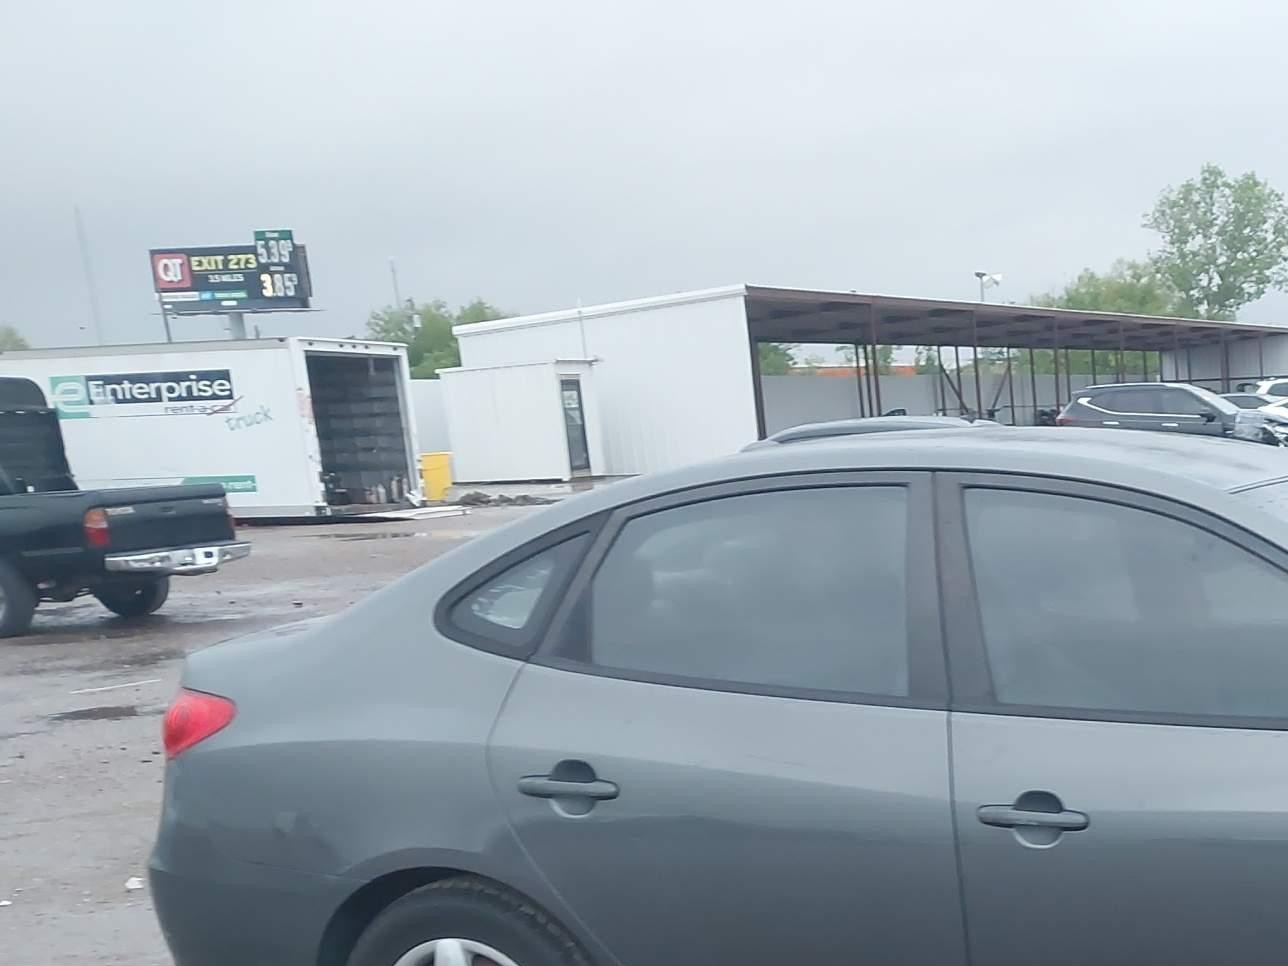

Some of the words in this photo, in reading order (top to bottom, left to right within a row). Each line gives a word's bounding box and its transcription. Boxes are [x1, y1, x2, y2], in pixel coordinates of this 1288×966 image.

[158, 258, 183, 282] QT
[190, 255, 225, 271] EXIT
[226, 253, 257, 269] 273
[88, 375, 231, 402] Enterprise
[225, 405, 273, 431] truck
